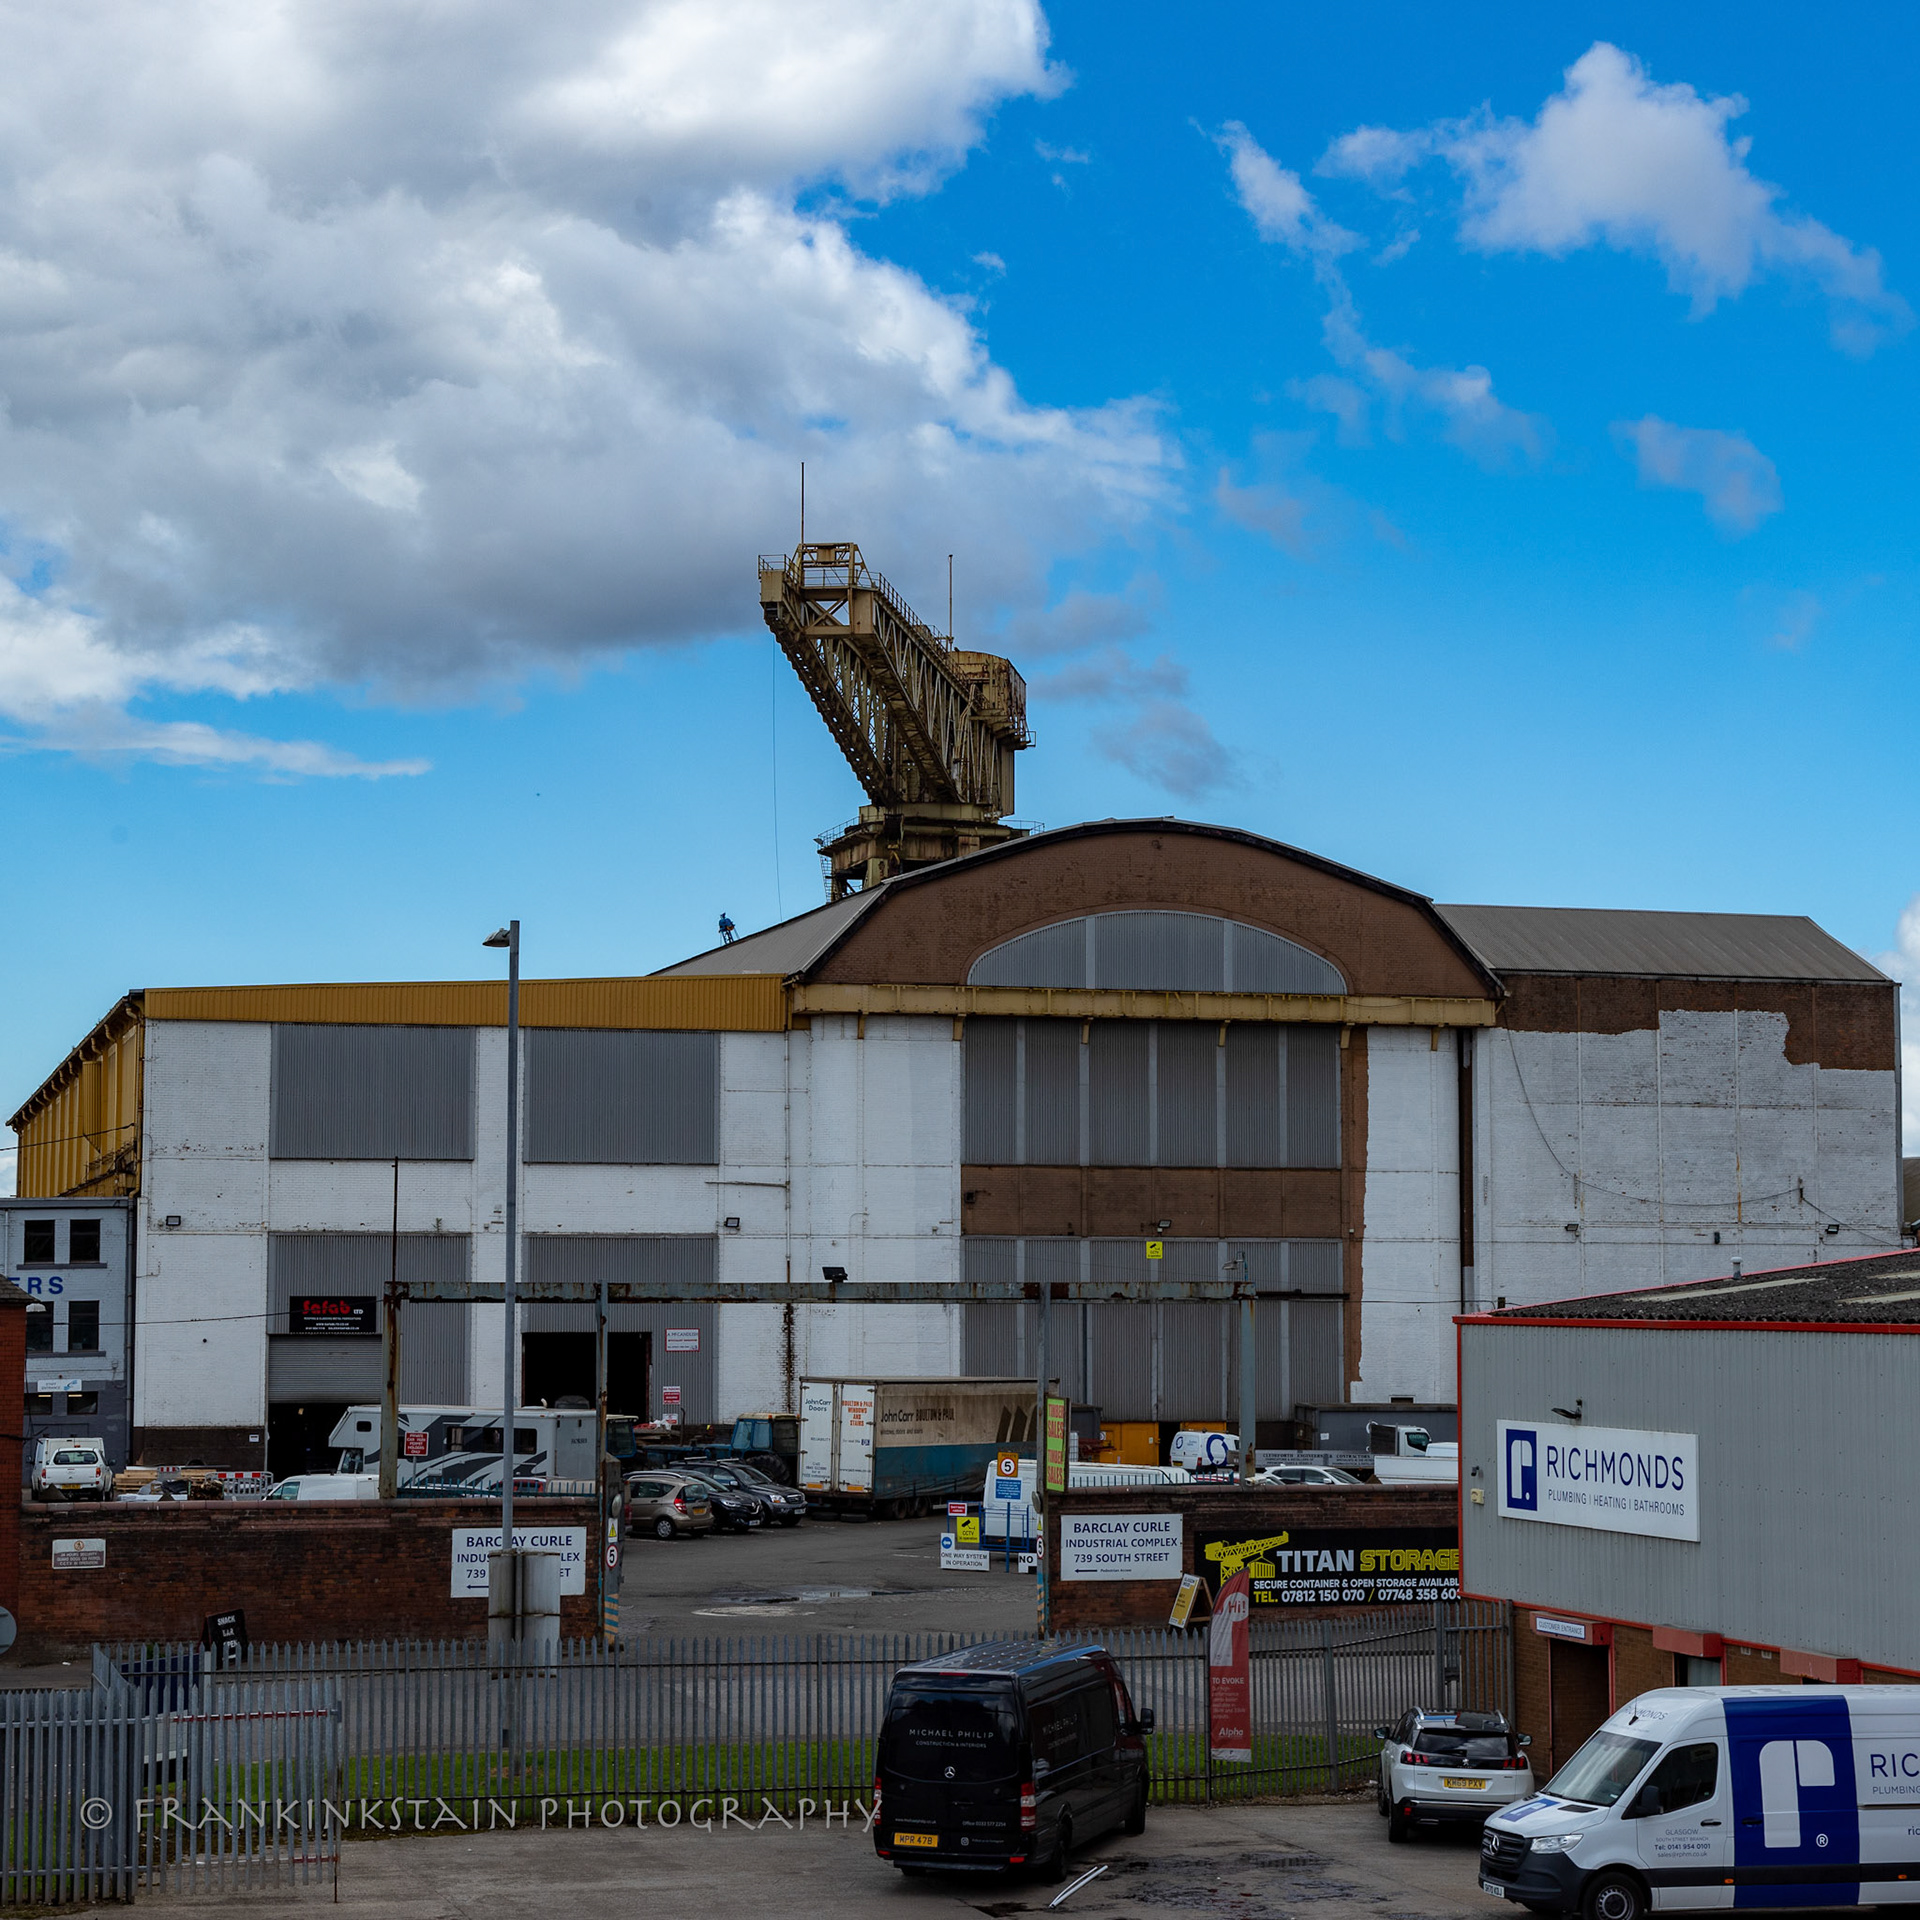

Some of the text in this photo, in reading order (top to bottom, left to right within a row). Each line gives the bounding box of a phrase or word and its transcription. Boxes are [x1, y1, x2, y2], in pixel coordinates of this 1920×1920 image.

[1048, 1420, 1064, 1439] SALES
[1004, 1461, 1011, 1472] 5
[1547, 1445, 1684, 1491] RICHMONDS
[1048, 1466, 1062, 1485] SALES
[1548, 1489, 1685, 1516] PLUMBING HEATING BATHROOMS
[1074, 1521, 1170, 1534] BARCLAY CURLE
[466, 1535, 572, 1547] BARCAY CURLE
[1039, 1541, 1042, 1554] 5
[1065, 1537, 1178, 1548] INDUSTRIAL COMPLEX
[609, 1550, 614, 1563] 5
[1074, 1553, 1169, 1563] 739 SOUTH STREET
[1276, 1549, 1459, 1572] TITAN STORAGE
[466, 1569, 486, 1579] 739
[1254, 1580, 1288, 1589] SECURE
[1289, 1579, 1340, 1589] CONTAINER
[1342, 1579, 1348, 1588] &
[1350, 1579, 1374, 1588] OPEN
[1376, 1578, 1417, 1587] STORAGE
[1254, 1591, 1278, 1603] TEL.
[1281, 1590, 1316, 1602] 07812
[1318, 1590, 1340, 1601] 150
[1342, 1589, 1366, 1601] 070
[1367, 1588, 1374, 1602] /
[1378, 1589, 1414, 1601] 07748
[1416, 1588, 1438, 1600] 358
[1228, 1600, 1246, 1615] Hi!
[217, 1615, 235, 1626] SNACK
[1538, 1620, 1582, 1636] CUSTOMER ENTRANCE
[909, 1729, 994, 1739] MICHAEL PHILIP
[1219, 1728, 1244, 1737] Alpha
[1870, 1753, 1920, 1778] RIC
